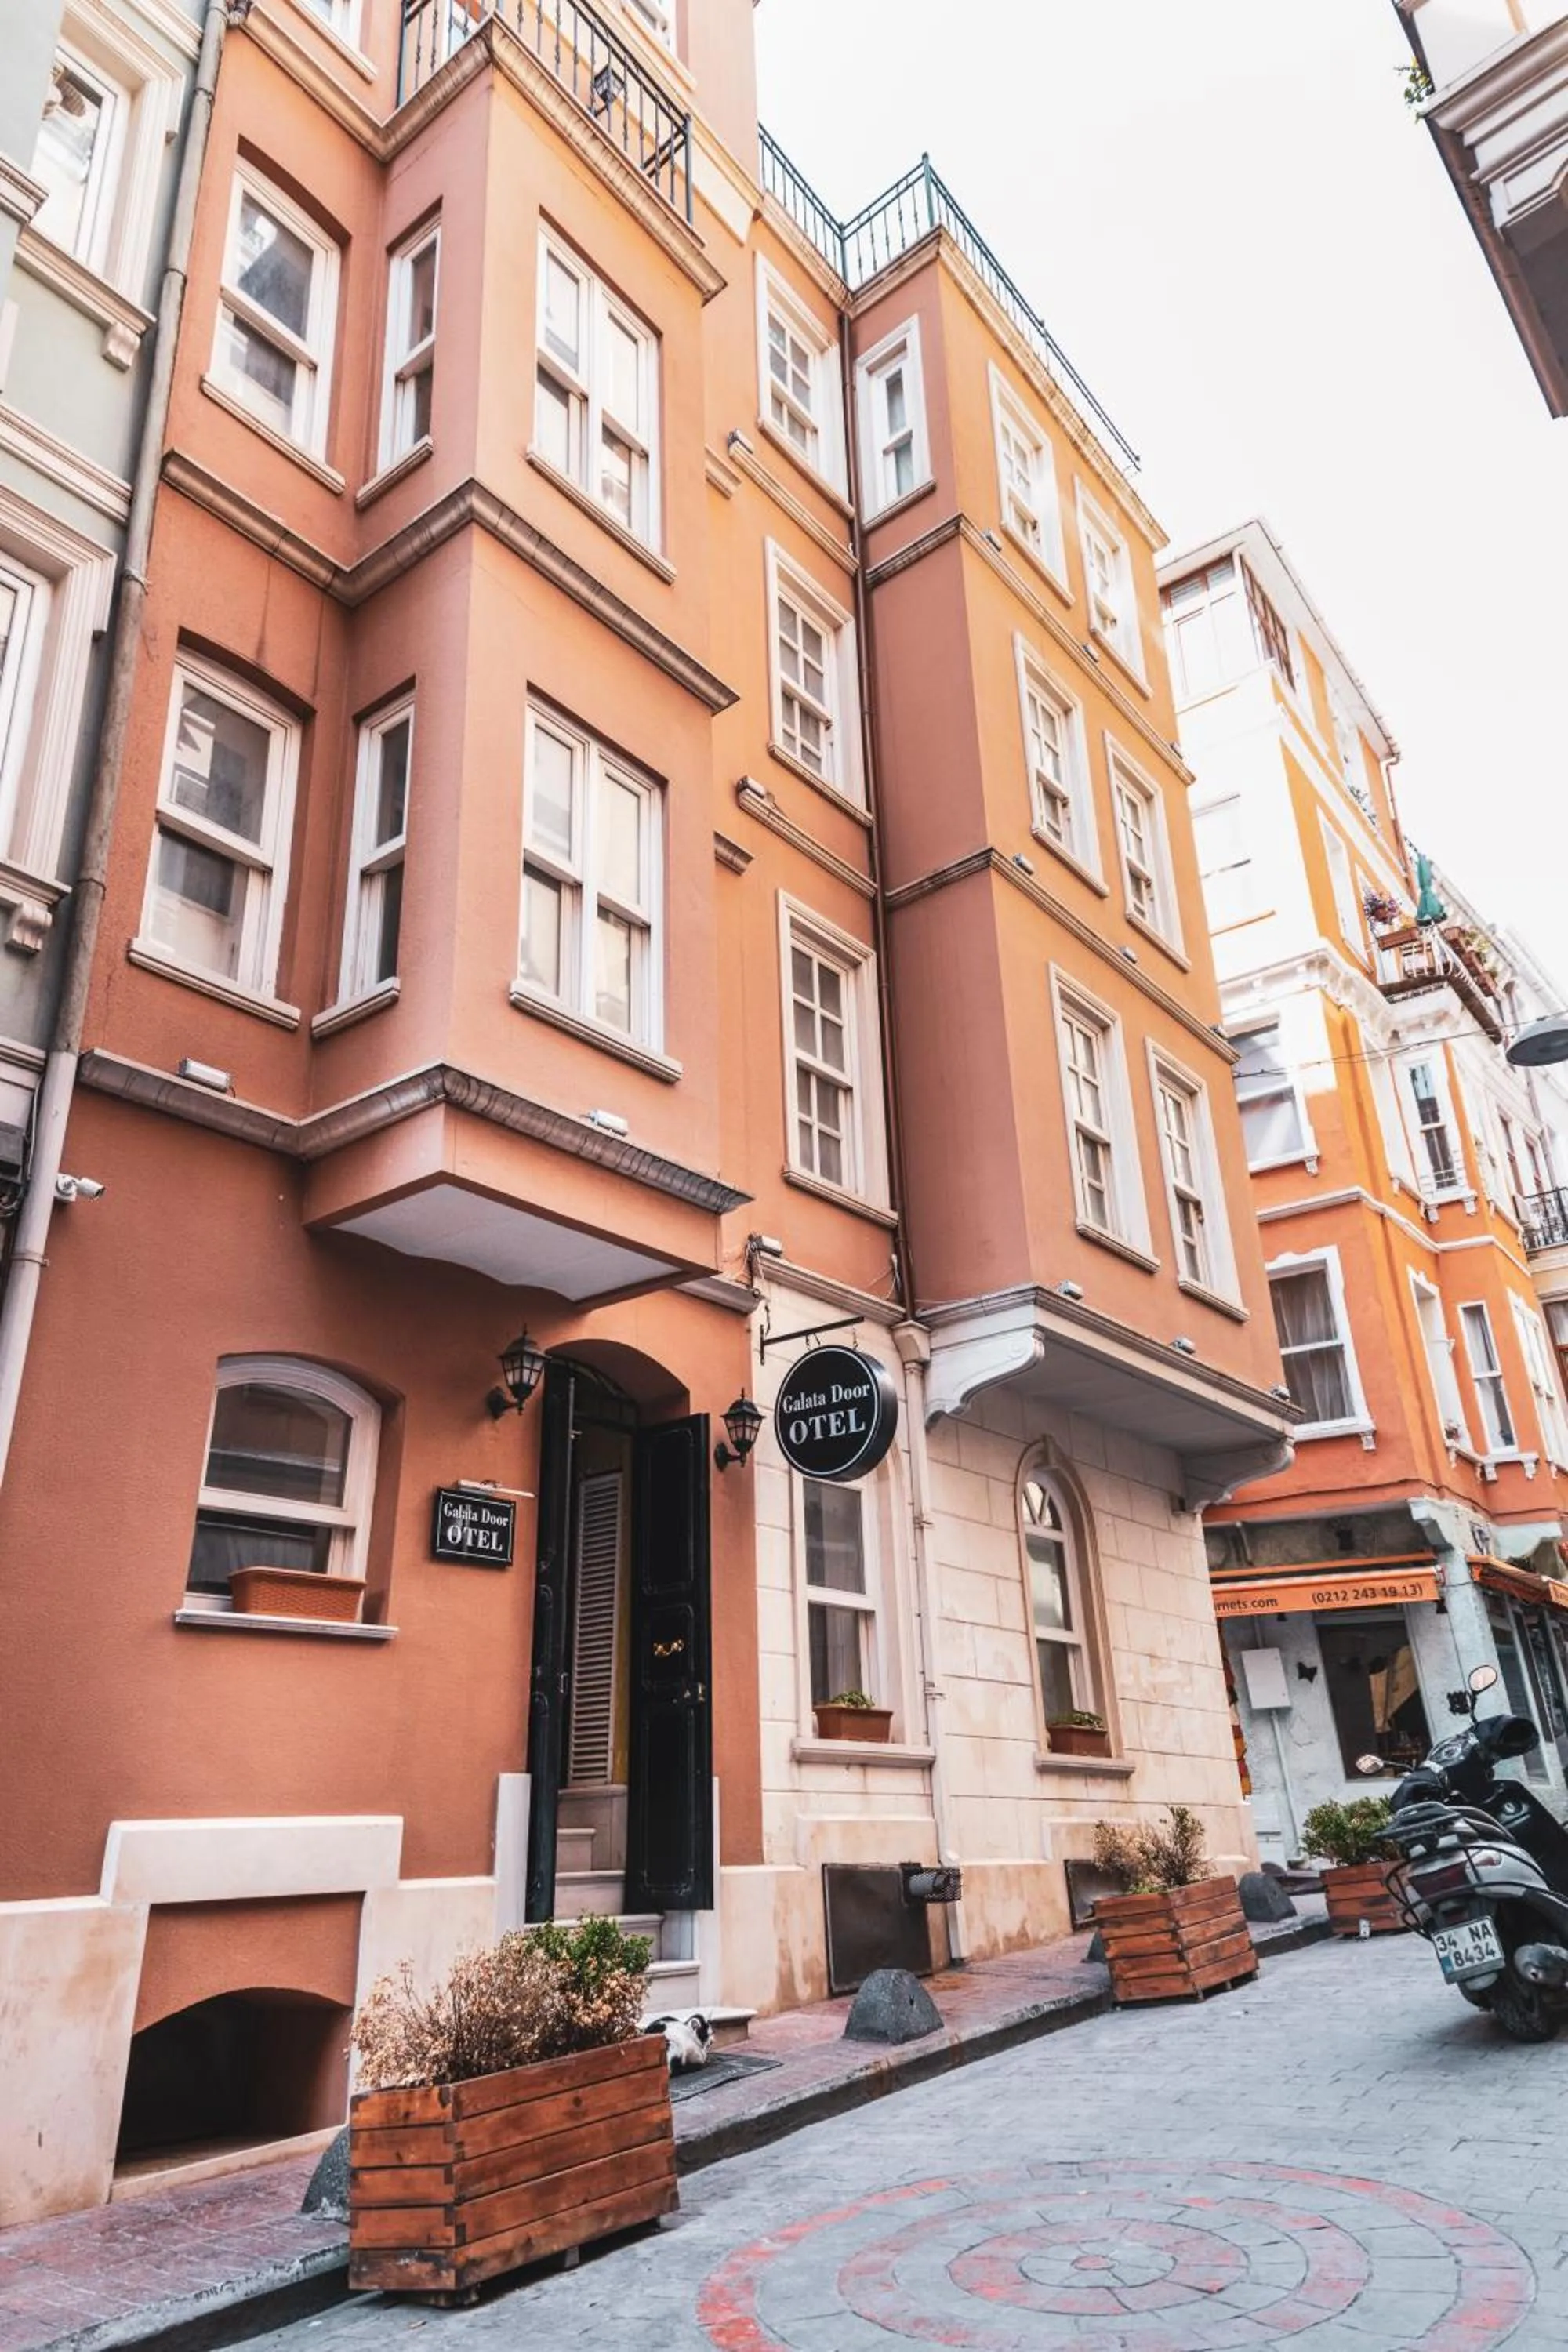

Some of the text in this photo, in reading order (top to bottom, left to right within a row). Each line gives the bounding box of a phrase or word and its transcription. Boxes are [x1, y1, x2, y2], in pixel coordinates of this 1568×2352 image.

[782, 1384, 870, 1413] Galata Door
[789, 1407, 866, 1444] OTEL
[444, 1502, 509, 1526] Galata Door
[447, 1525, 503, 1551] OTEL
[1312, 1590, 1348, 1605] (0212
[1352, 1588, 1377, 1600] 243
[1402, 1582, 1423, 1595] 13)
[1436, 1922, 1493, 1951] 34 NA
[1453, 1943, 1496, 1967] 8434
